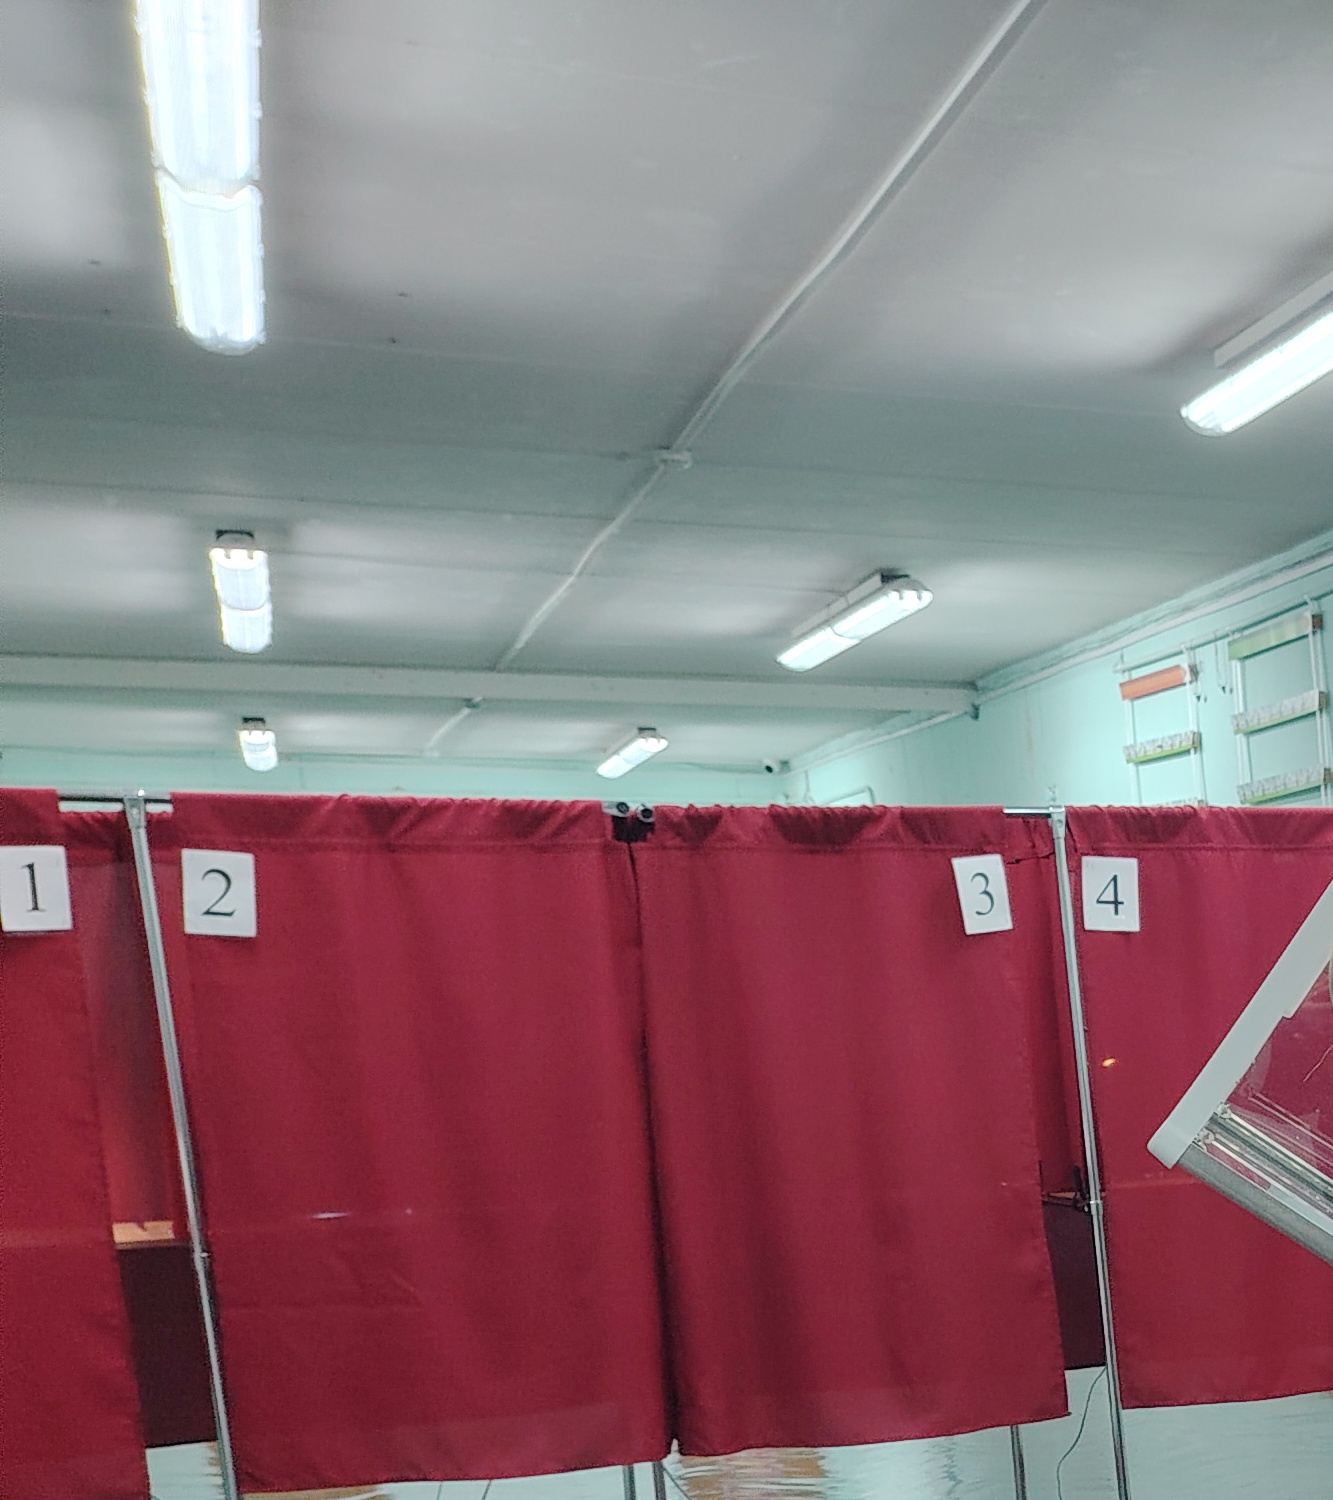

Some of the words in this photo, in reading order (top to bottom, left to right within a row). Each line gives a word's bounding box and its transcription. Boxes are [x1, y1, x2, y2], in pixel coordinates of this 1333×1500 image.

[22, 862, 46, 912] 1
[202, 868, 235, 917] 2
[971, 872, 995, 916] 3
[1096, 874, 1124, 916] 4
